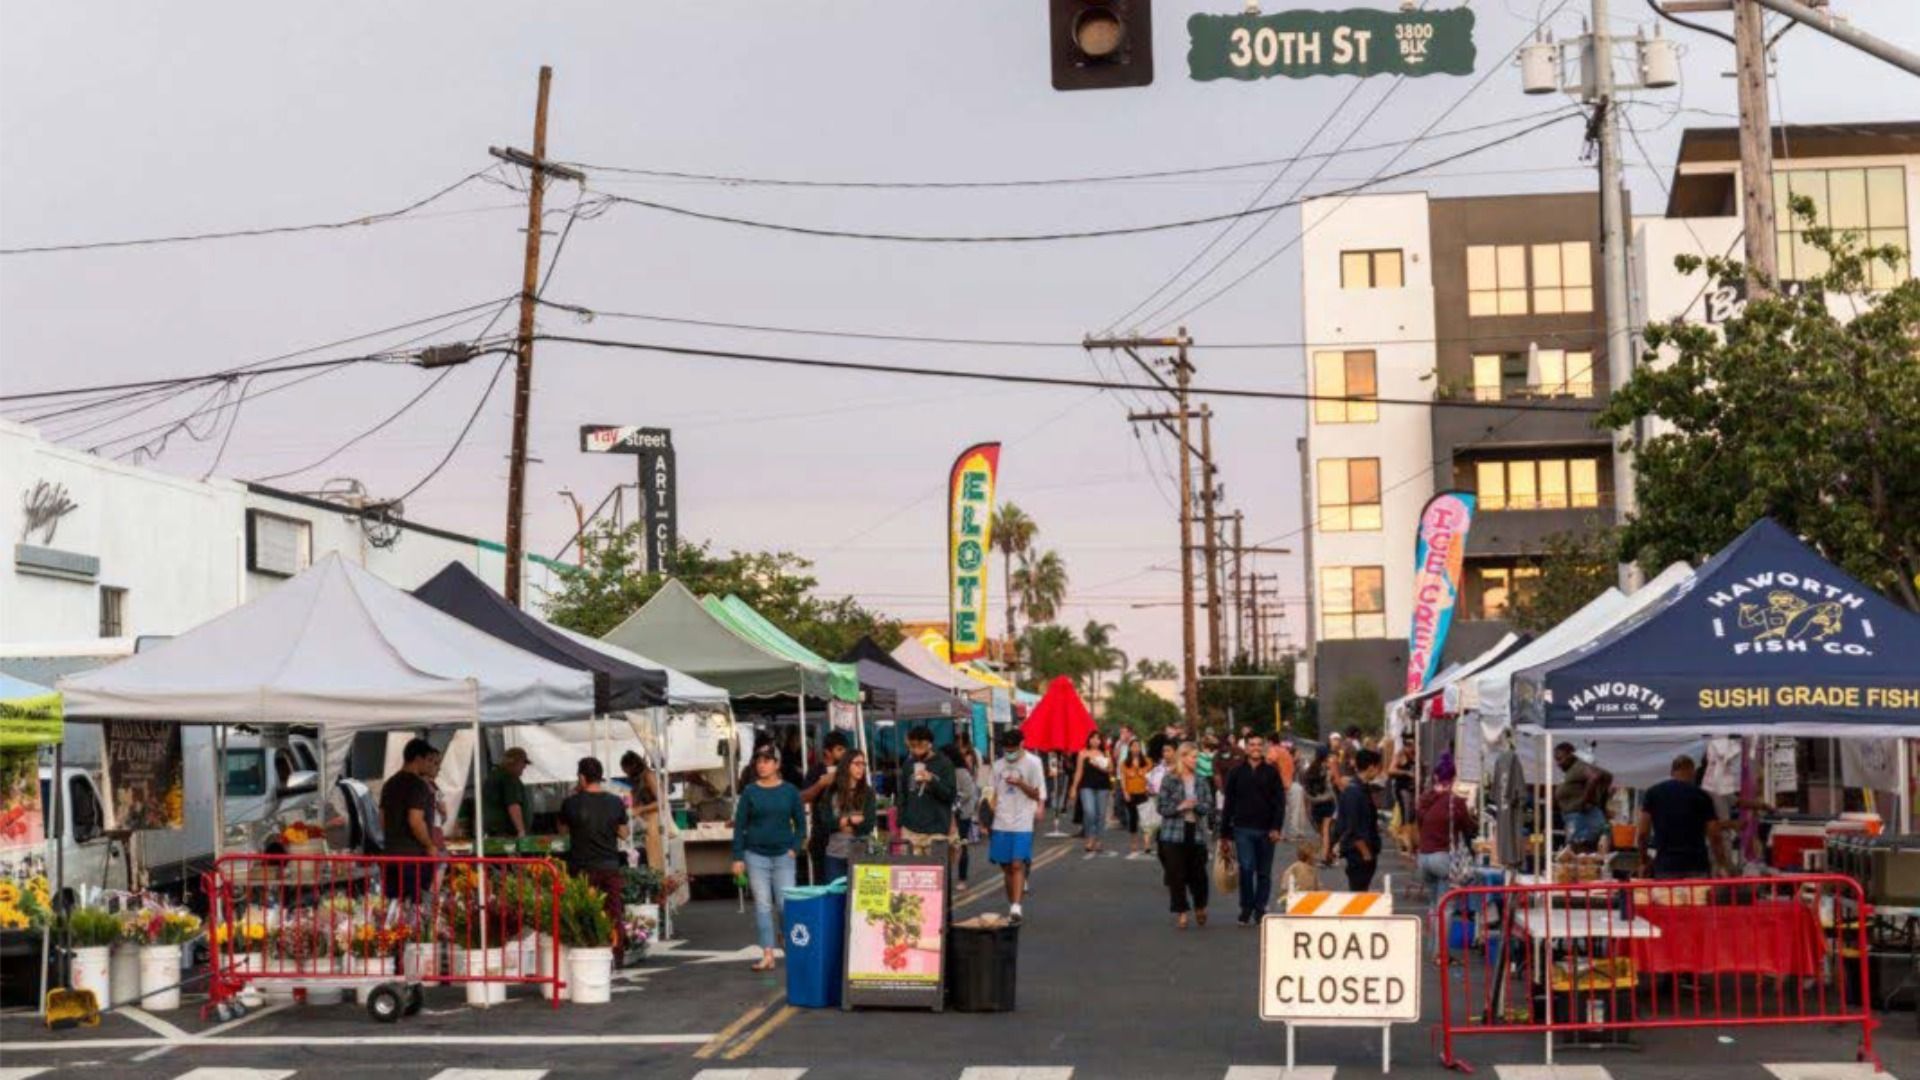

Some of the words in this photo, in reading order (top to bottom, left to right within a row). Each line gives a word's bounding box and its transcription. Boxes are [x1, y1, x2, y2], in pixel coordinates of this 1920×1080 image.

[1229, 26, 1321, 68] 30TH
[1332, 25, 1371, 64] ST
[1395, 23, 1434, 40] 3800
[1400, 39, 1428, 55] BLK
[626, 432, 667, 449] street
[655, 455, 667, 507] ART
[956, 471, 987, 642] ELOTE
[1425, 508, 1453, 575] ICE
[1707, 572, 1865, 609] HAWORTH
[1734, 639, 1807, 655] FISH
[1823, 641, 1873, 657] CO.
[1568, 682, 1665, 712] HAWORTH
[1595, 703, 1619, 713] FISH
[1623, 703, 1639, 712] CO.
[1699, 687, 1769, 708] SUSHI
[1776, 686, 1860, 707] GRADE
[1866, 687, 1920, 708] FISH
[1293, 931, 1389, 961] ROAD
[1276, 975, 1405, 1005] CLOSED
